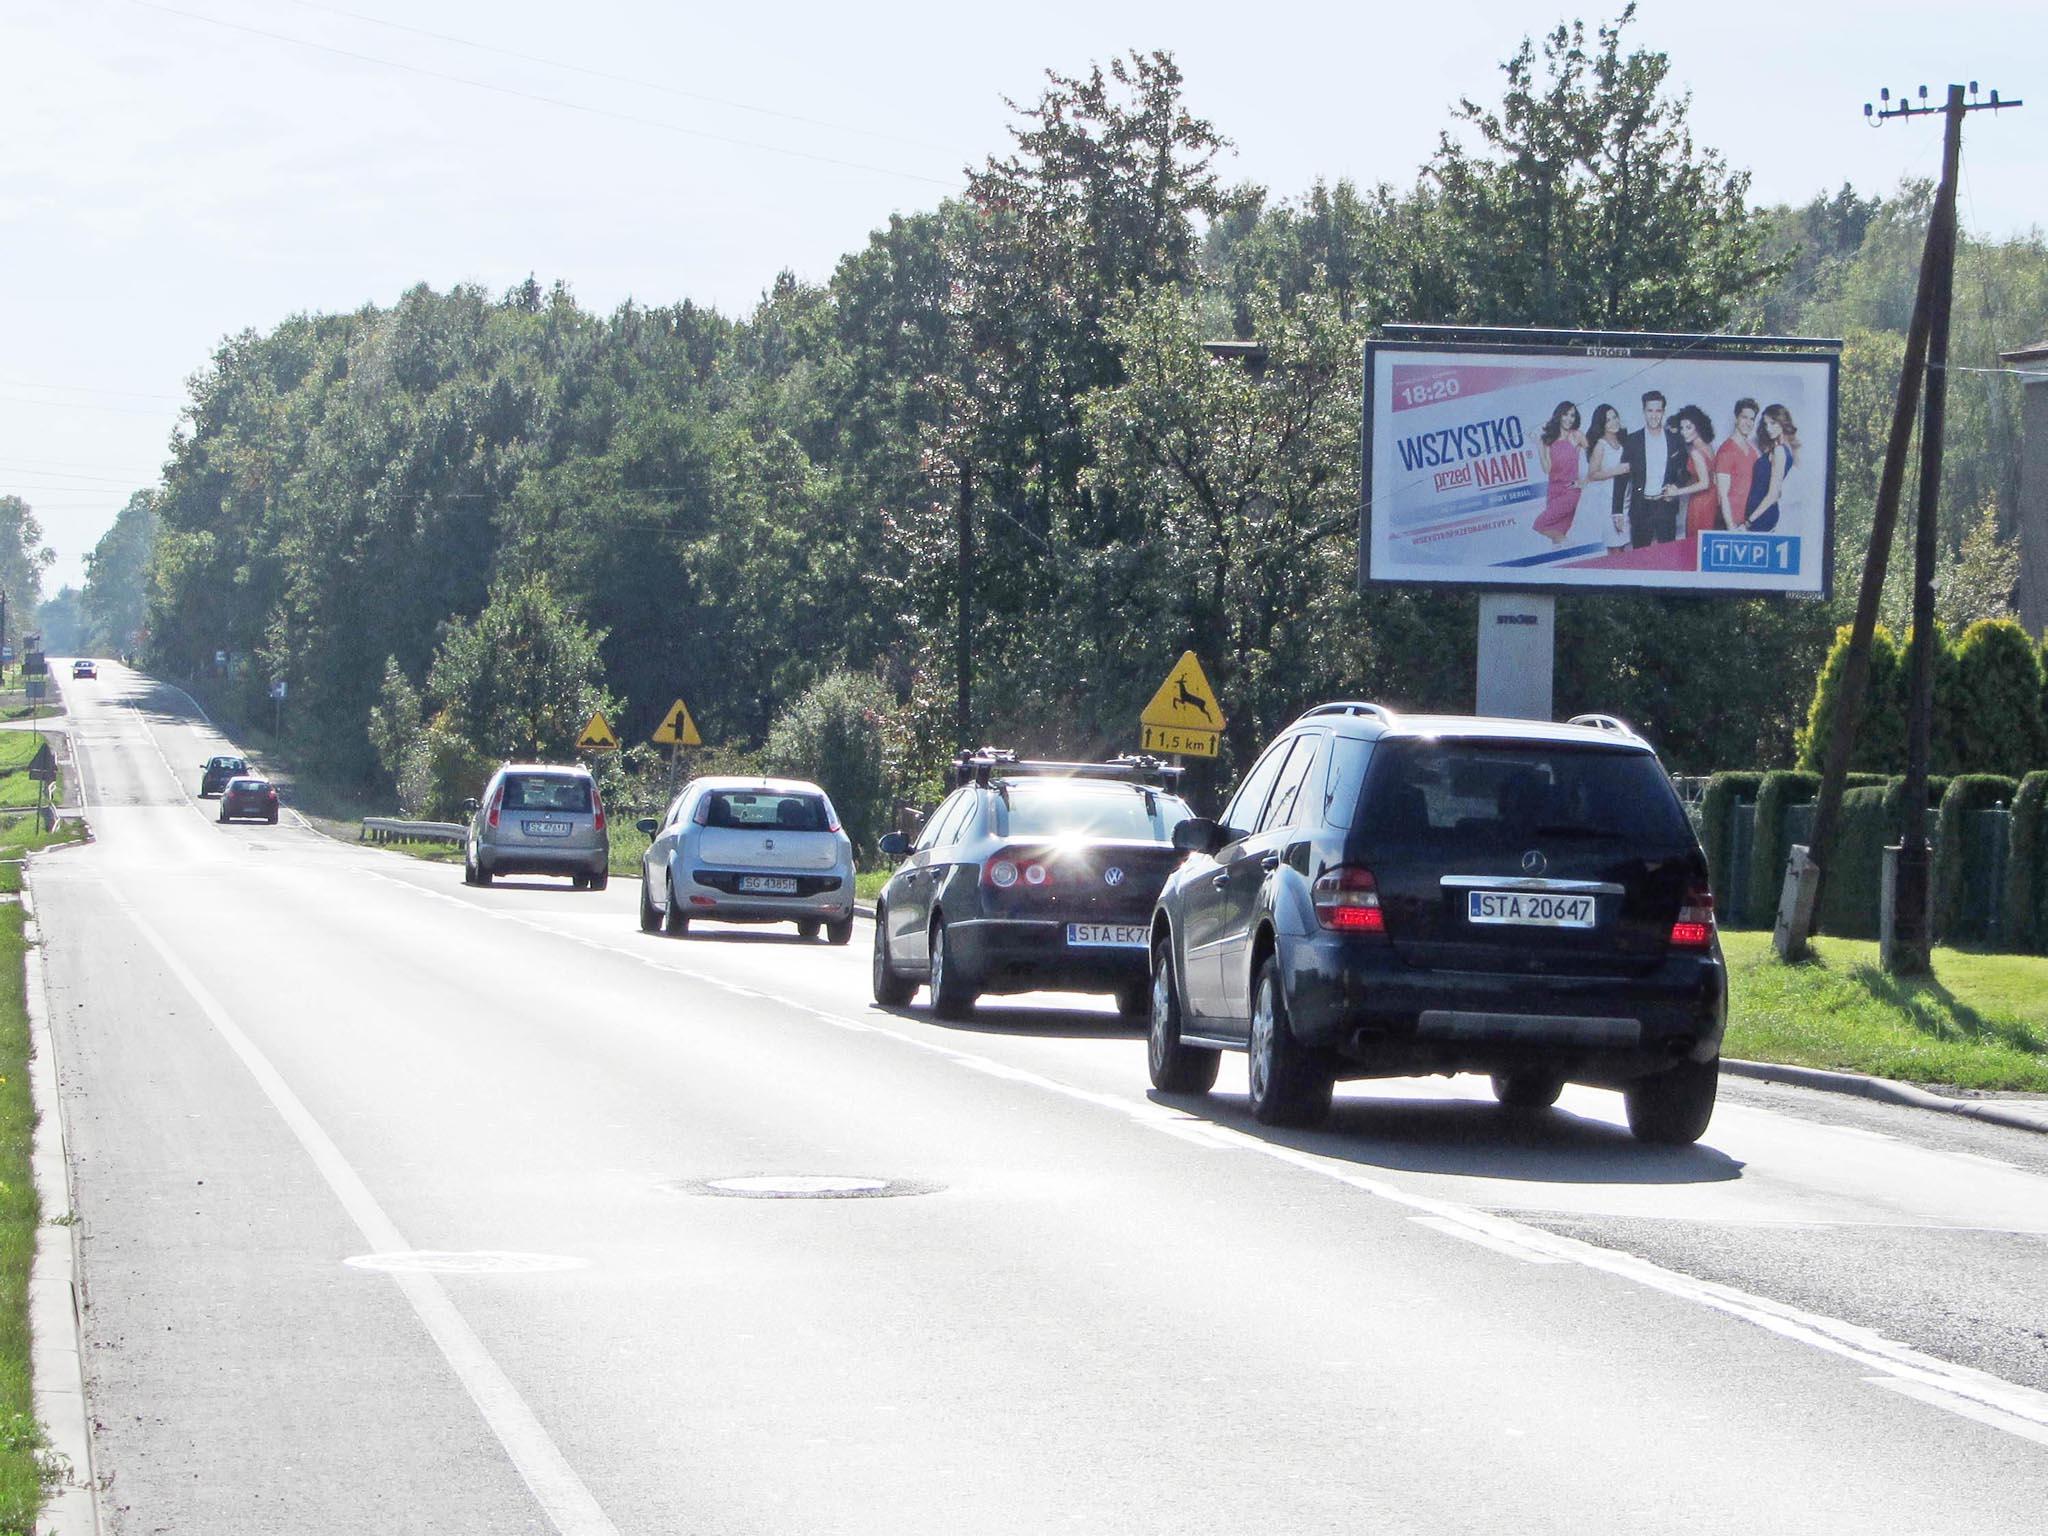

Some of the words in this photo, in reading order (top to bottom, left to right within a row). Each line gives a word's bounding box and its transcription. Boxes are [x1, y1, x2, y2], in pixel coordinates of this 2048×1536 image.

[1402, 378, 1459, 405] 18:20
[1397, 415, 1524, 471] WSZYSTKO
[1434, 463, 1472, 493] przed
[1474, 451, 1528, 487] NAMI
[1715, 543, 1764, 563] TVP
[1776, 541, 1789, 568] 1
[1159, 732, 1180, 749] 1,5
[1186, 738, 1205, 752] km
[745, 877, 760, 888] SG
[1482, 896, 1521, 918] STA
[1528, 898, 1590, 920] 20647
[1079, 926, 1111, 942] STA
